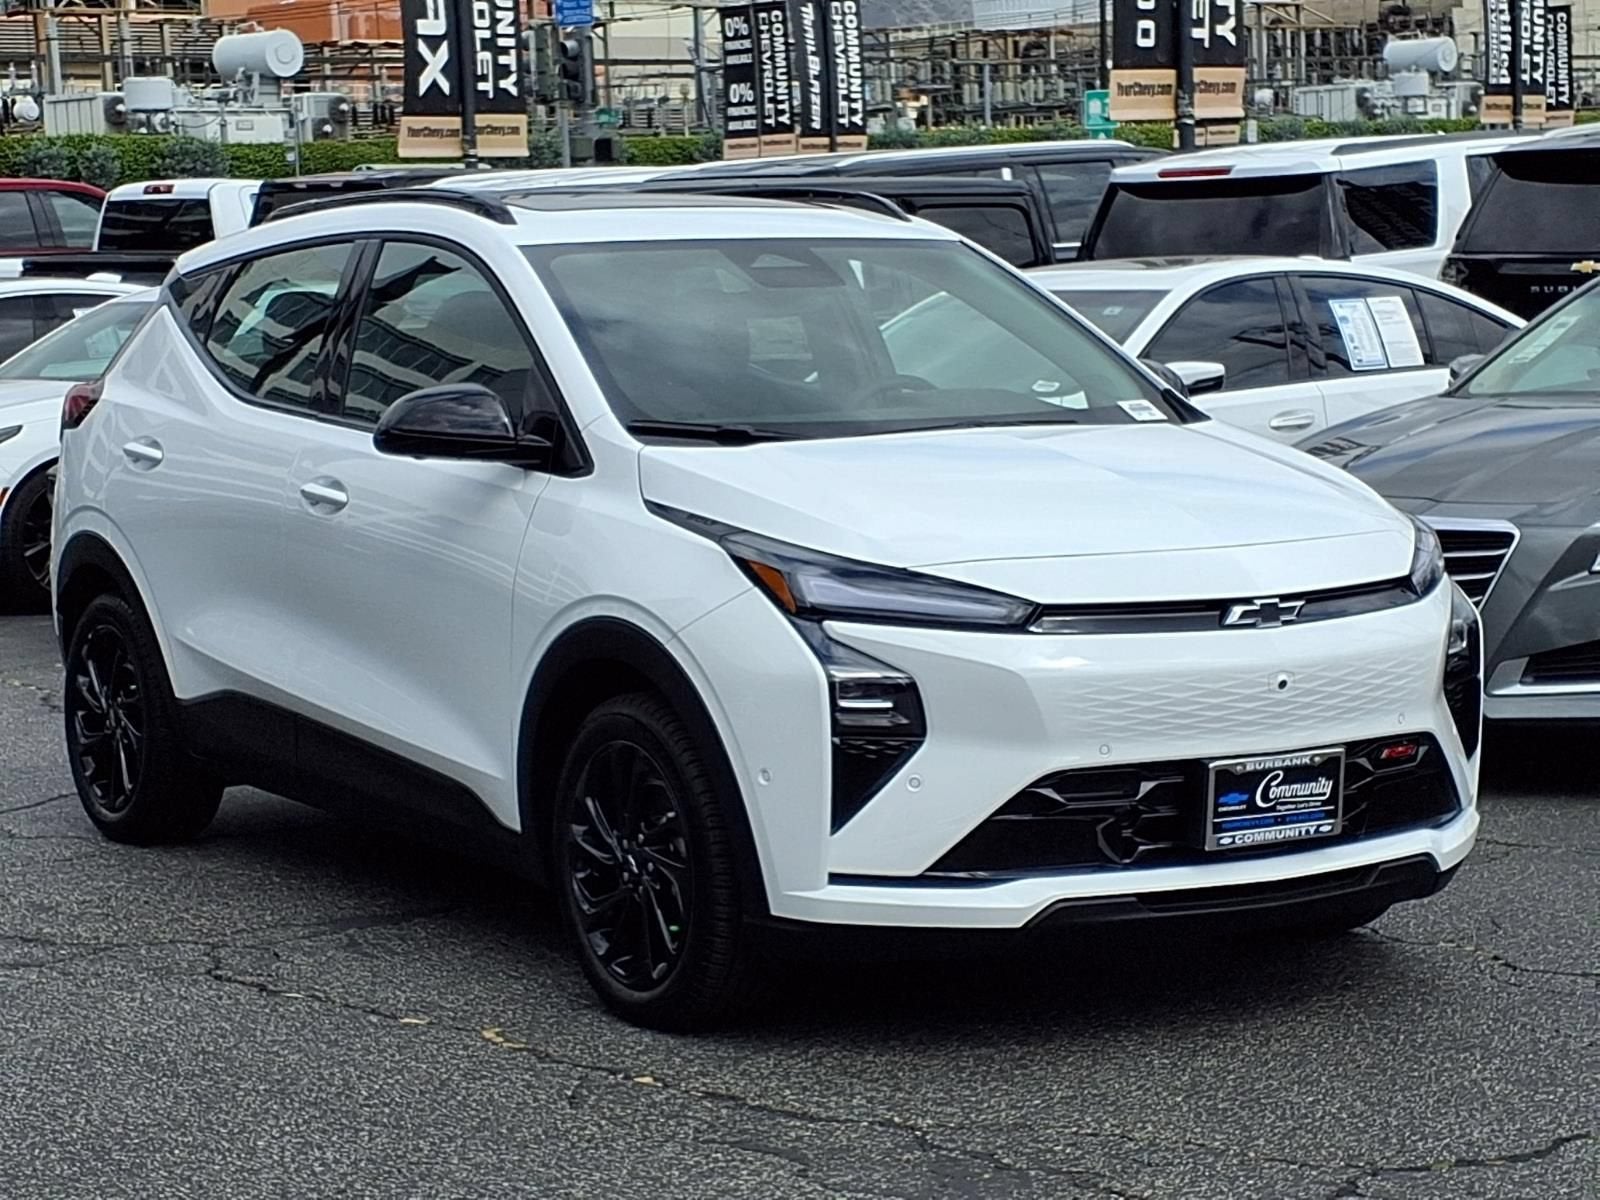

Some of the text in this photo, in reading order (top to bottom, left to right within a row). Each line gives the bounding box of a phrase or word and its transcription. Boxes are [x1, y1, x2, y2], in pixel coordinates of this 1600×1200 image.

[725, 16, 749, 37] 0%
[1557, 12, 1569, 104] COMMUNITY
[730, 82, 754, 103] 0%
[758, 12, 775, 127] CHEVROLET
[771, 10, 791, 126] COMMUNITY
[831, 2, 849, 128] CHEVROLET
[843, 1, 863, 127] COMMUNITY
[1246, 756, 1311, 771] BURBANK
[1255, 770, 1333, 808] Community
[1234, 825, 1317, 844] COMMUNITY
